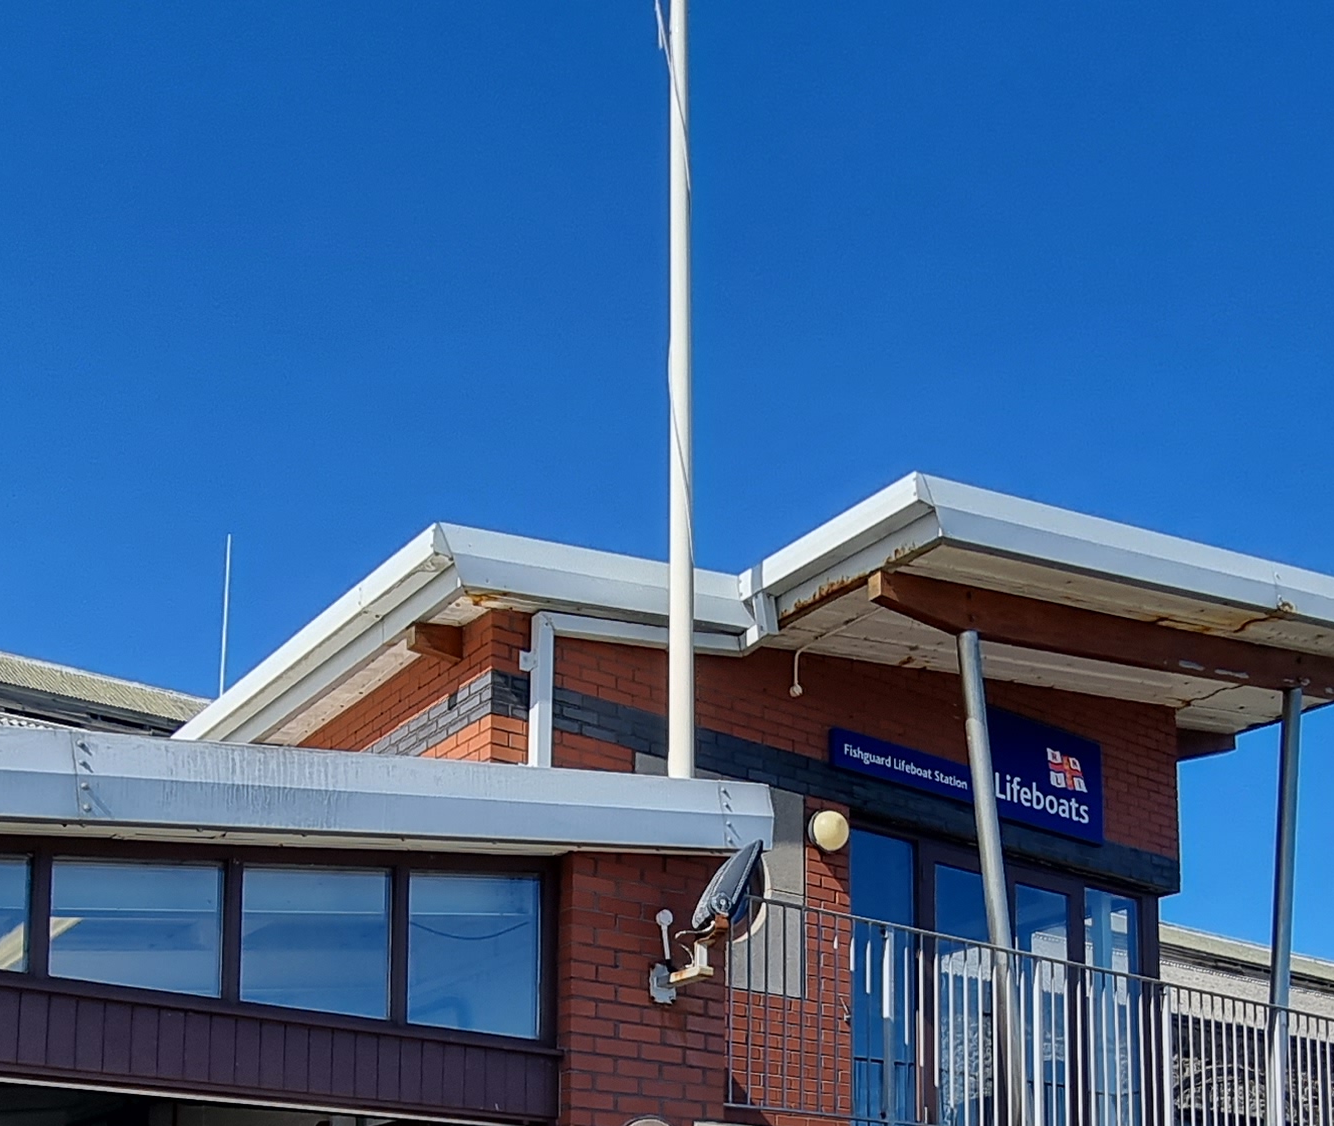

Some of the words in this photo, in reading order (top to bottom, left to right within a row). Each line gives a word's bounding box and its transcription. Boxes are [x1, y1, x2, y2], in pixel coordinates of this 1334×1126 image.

[843, 743, 892, 769] Fishguard
[893, 757, 933, 780] Lifeboat
[934, 770, 968, 791] Station
[994, 771, 1090, 824] Lifeboats
